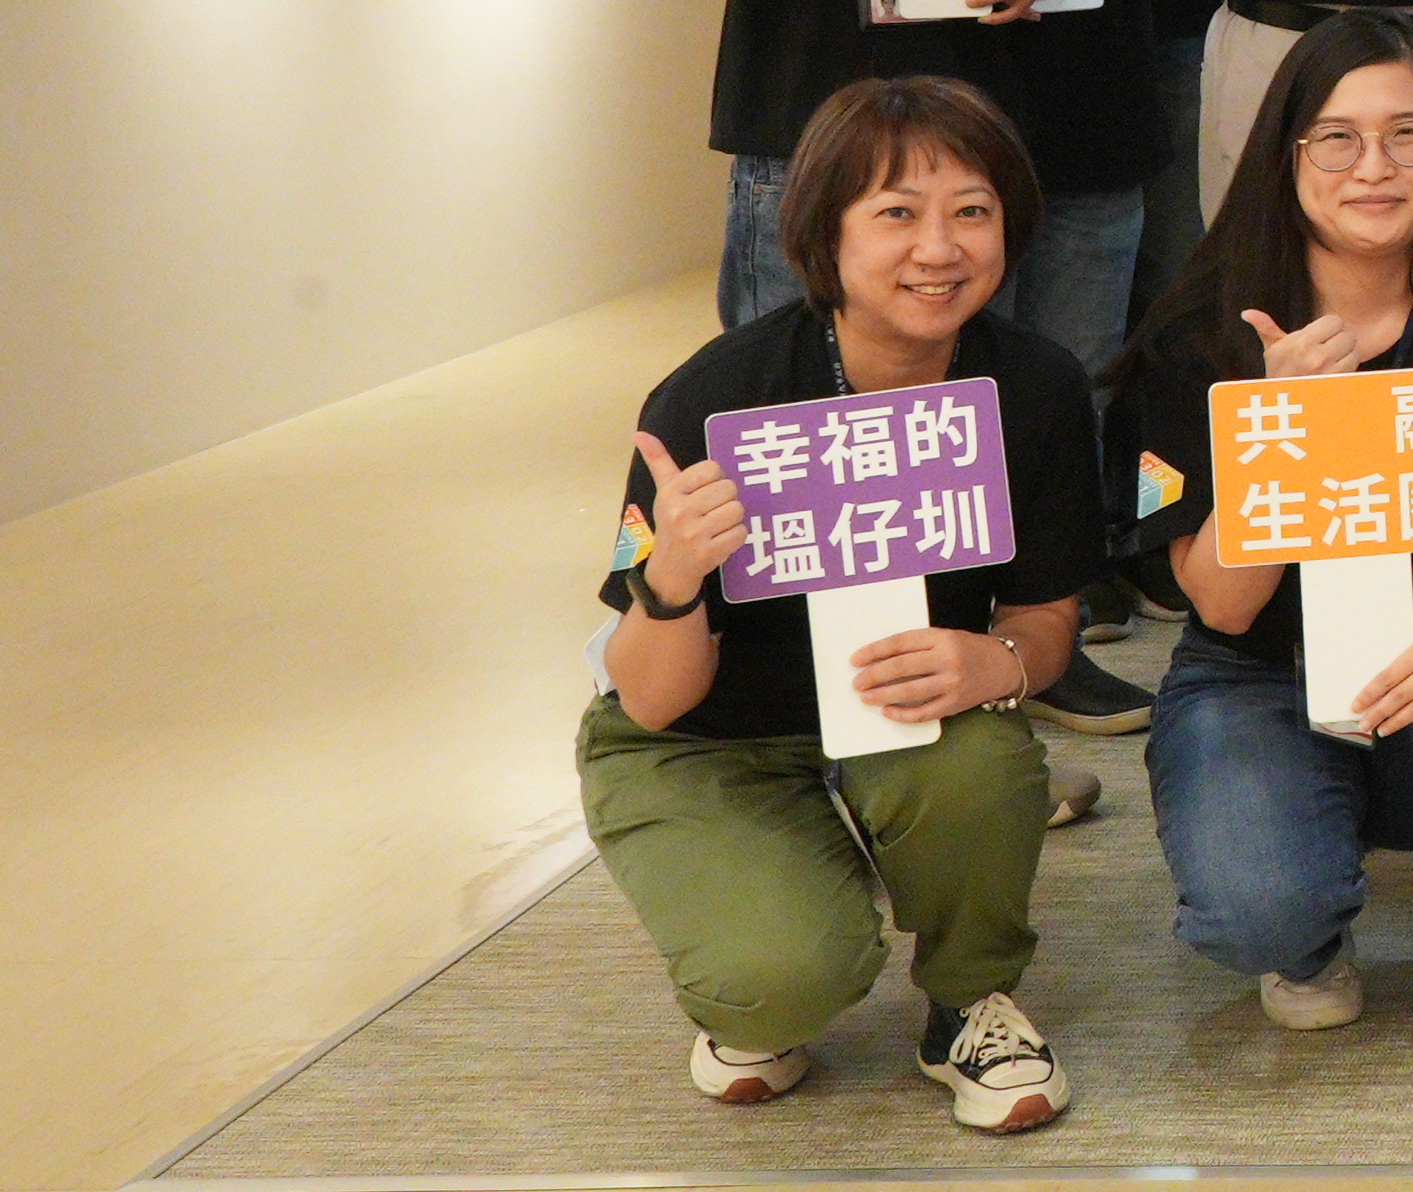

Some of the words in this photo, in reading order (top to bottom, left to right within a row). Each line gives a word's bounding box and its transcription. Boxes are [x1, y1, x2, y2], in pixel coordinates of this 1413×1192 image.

[733, 396, 979, 494] 幸福的
[744, 484, 992, 585] 塭仔圳
